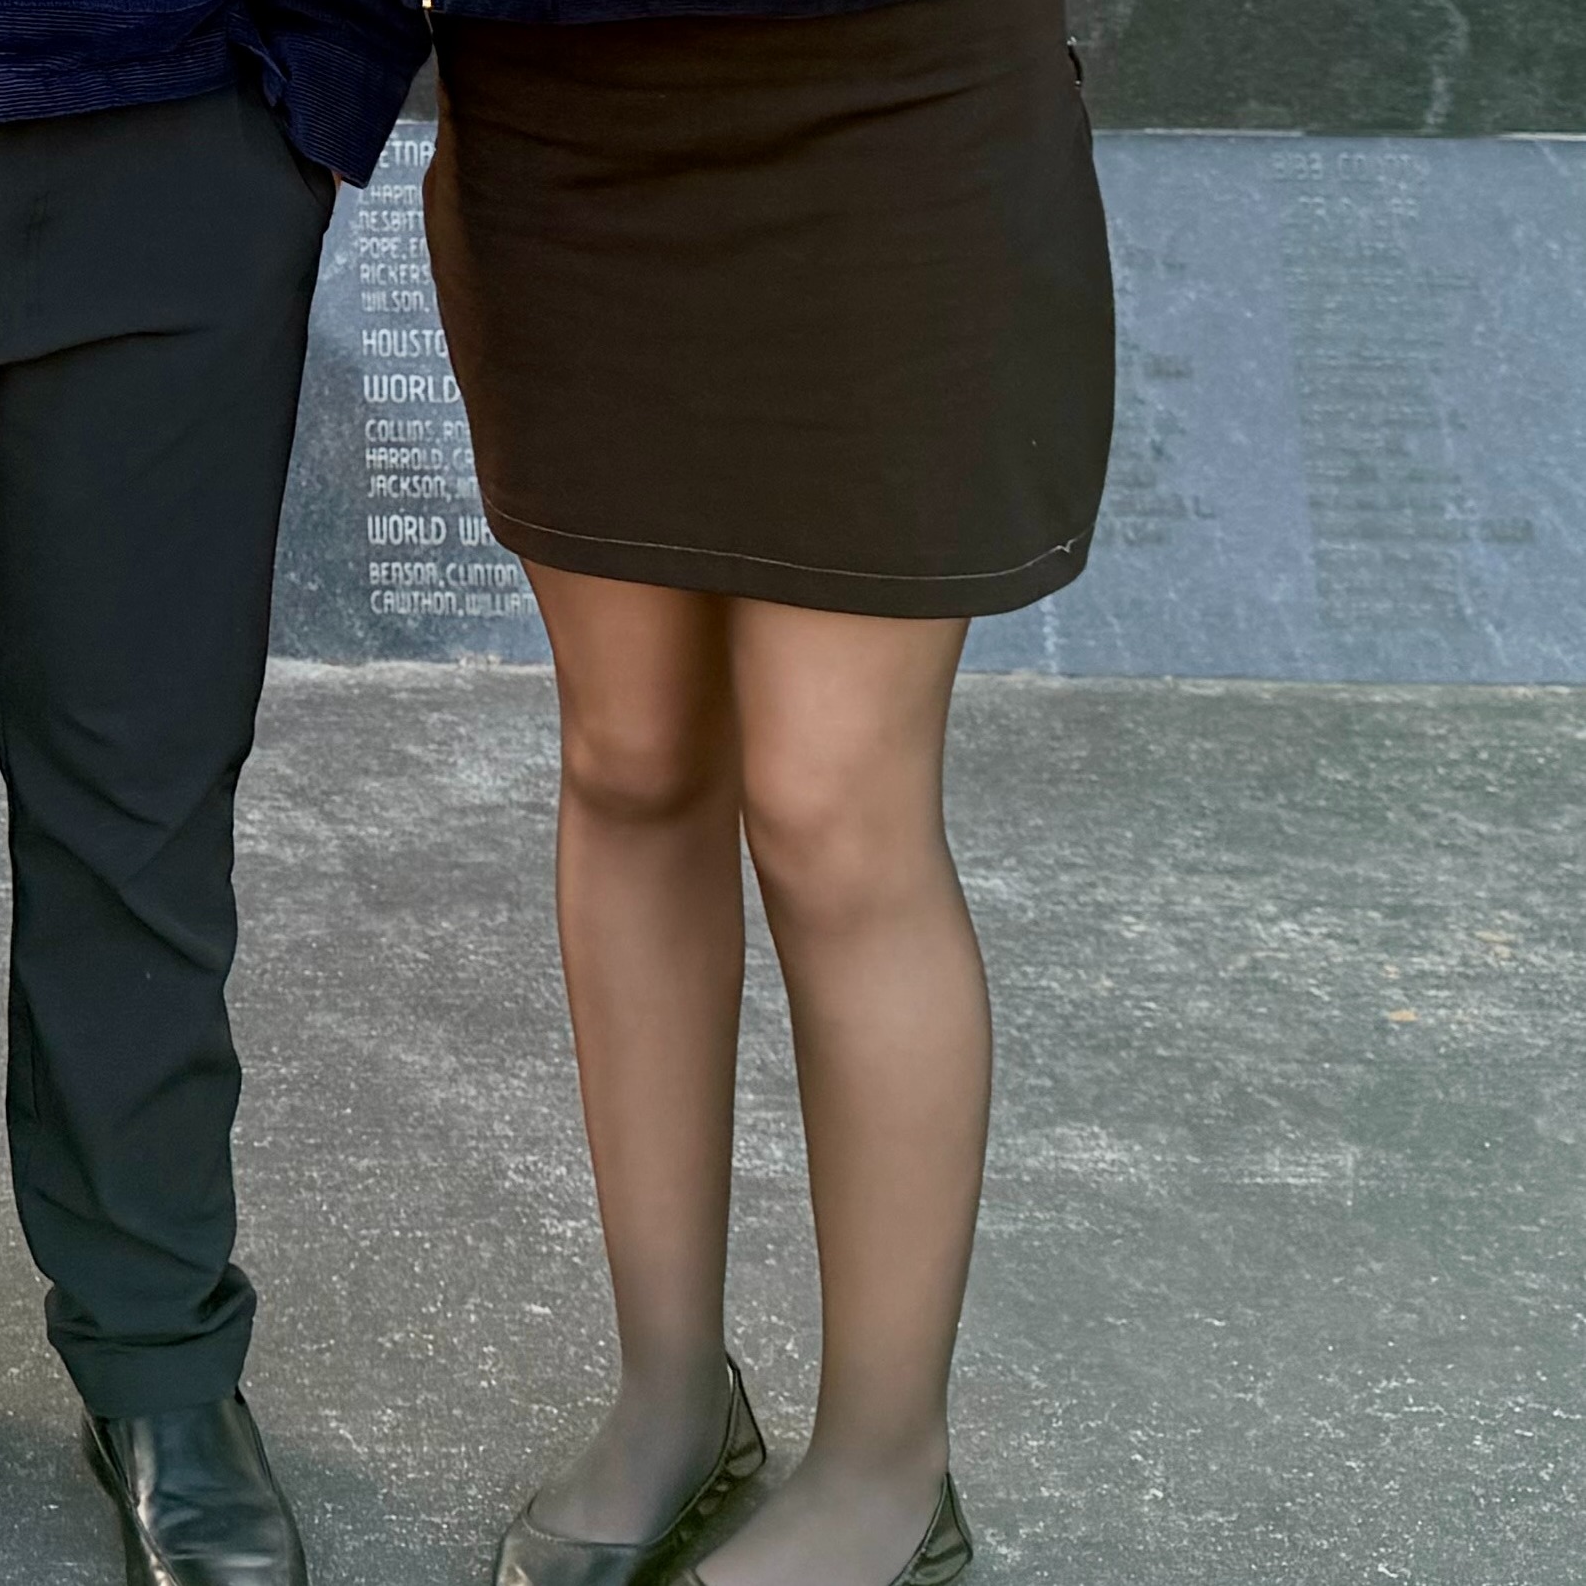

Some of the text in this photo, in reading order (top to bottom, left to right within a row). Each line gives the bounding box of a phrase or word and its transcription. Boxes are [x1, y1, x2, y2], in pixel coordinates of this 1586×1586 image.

[361, 328, 449, 358] HOUSTO
[363, 373, 462, 404] WORLD
[367, 514, 448, 546] WORLD
[446, 562, 519, 588] CLINTON
